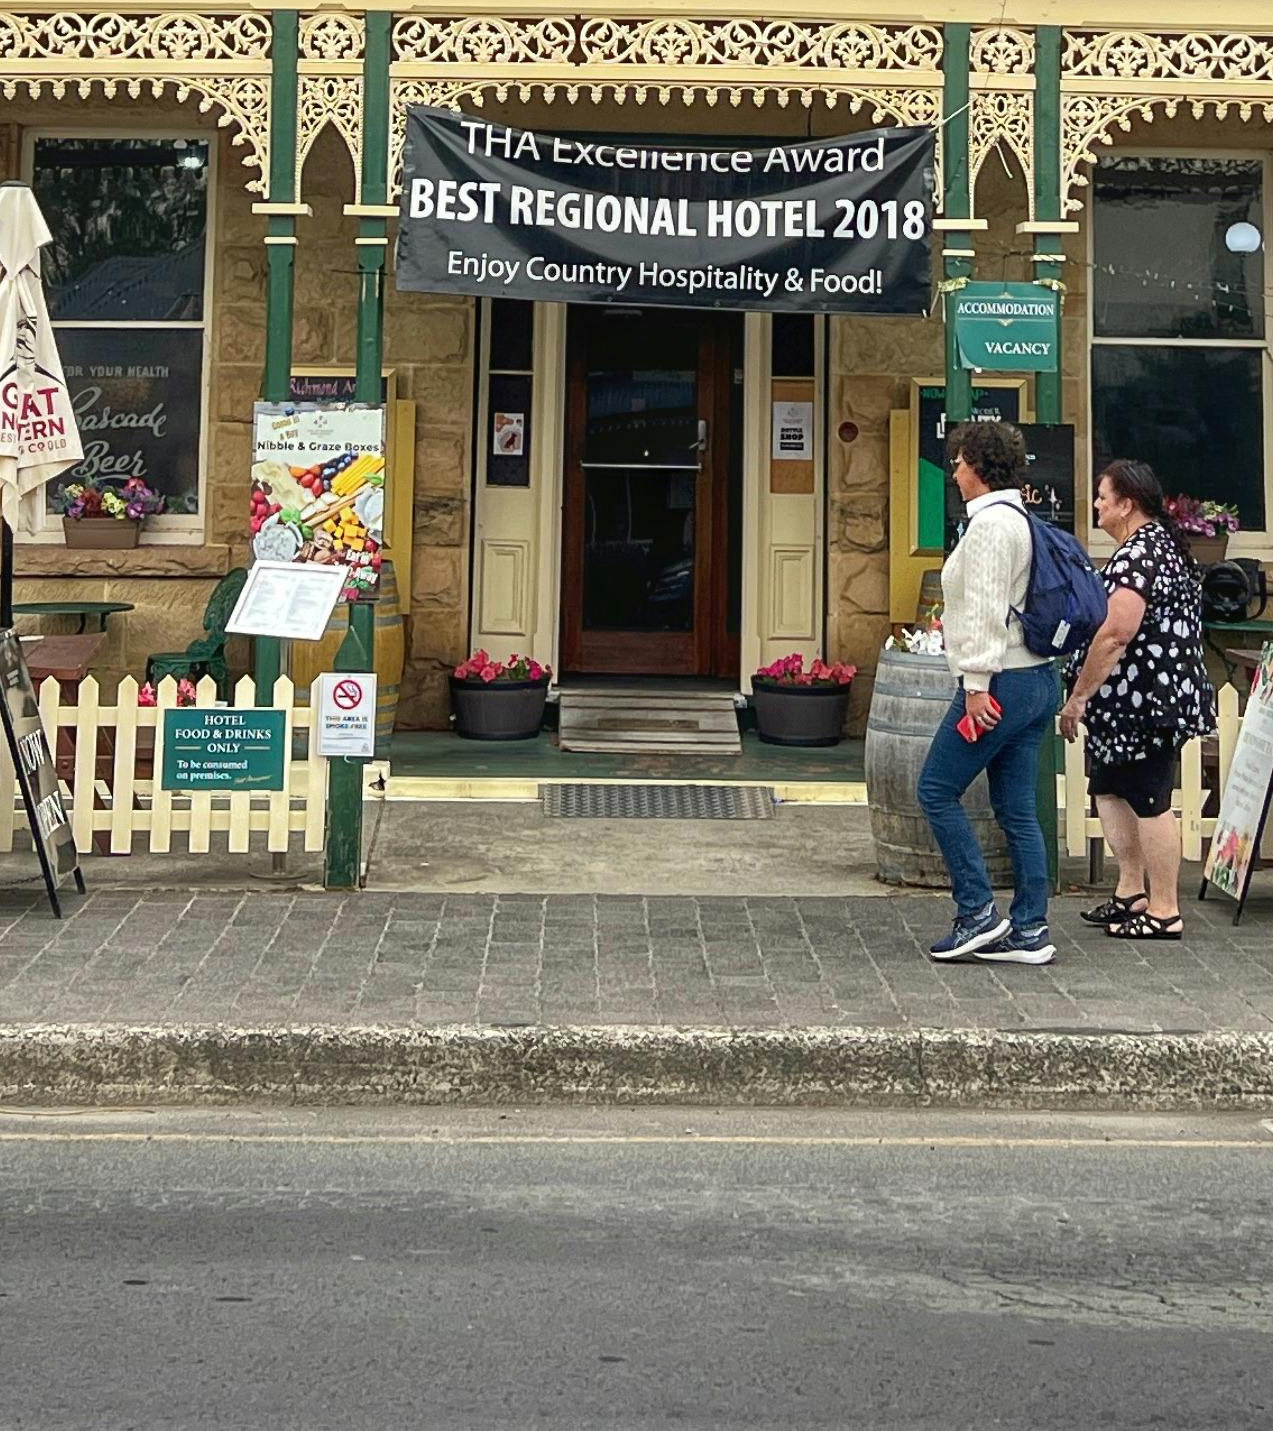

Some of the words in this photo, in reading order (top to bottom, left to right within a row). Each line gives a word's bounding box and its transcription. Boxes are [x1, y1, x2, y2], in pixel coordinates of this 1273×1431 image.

[460, 121, 541, 161] THA
[763, 137, 885, 173] Award
[409, 178, 501, 224] BEST
[509, 185, 697, 237] REGIONAL
[707, 199, 825, 238] HOTEL
[833, 199, 925, 240] 2018
[448, 250, 521, 285] Enjoy
[526, 256, 633, 289] Country
[639, 262, 779, 297] Hospitality
[784, 267, 804, 292] &
[810, 268, 883, 294] Food!
[957, 302, 1054, 316] ACCOMMODATION
[985, 342, 1051, 355] VACANCY
[90, 366, 122, 377] YOUR
[128, 366, 168, 378] HEALTH
[257, 440, 295, 451] Nibble
[298, 441, 306, 451] &
[309, 441, 342, 451] Graze
[344, 441, 380, 452] Boxes
[71, 440, 148, 478] Beer
[204, 715, 247, 726] HOTEL
[175, 728, 210, 740] FOOD
[212, 728, 223, 740] &
[225, 728, 272, 741] DRINKS
[207, 743, 241, 754] ONLY
[176, 759, 189, 769] To
[190, 759, 202, 769] be
[202, 759, 248, 770] consumed
[176, 771, 188, 780] on
